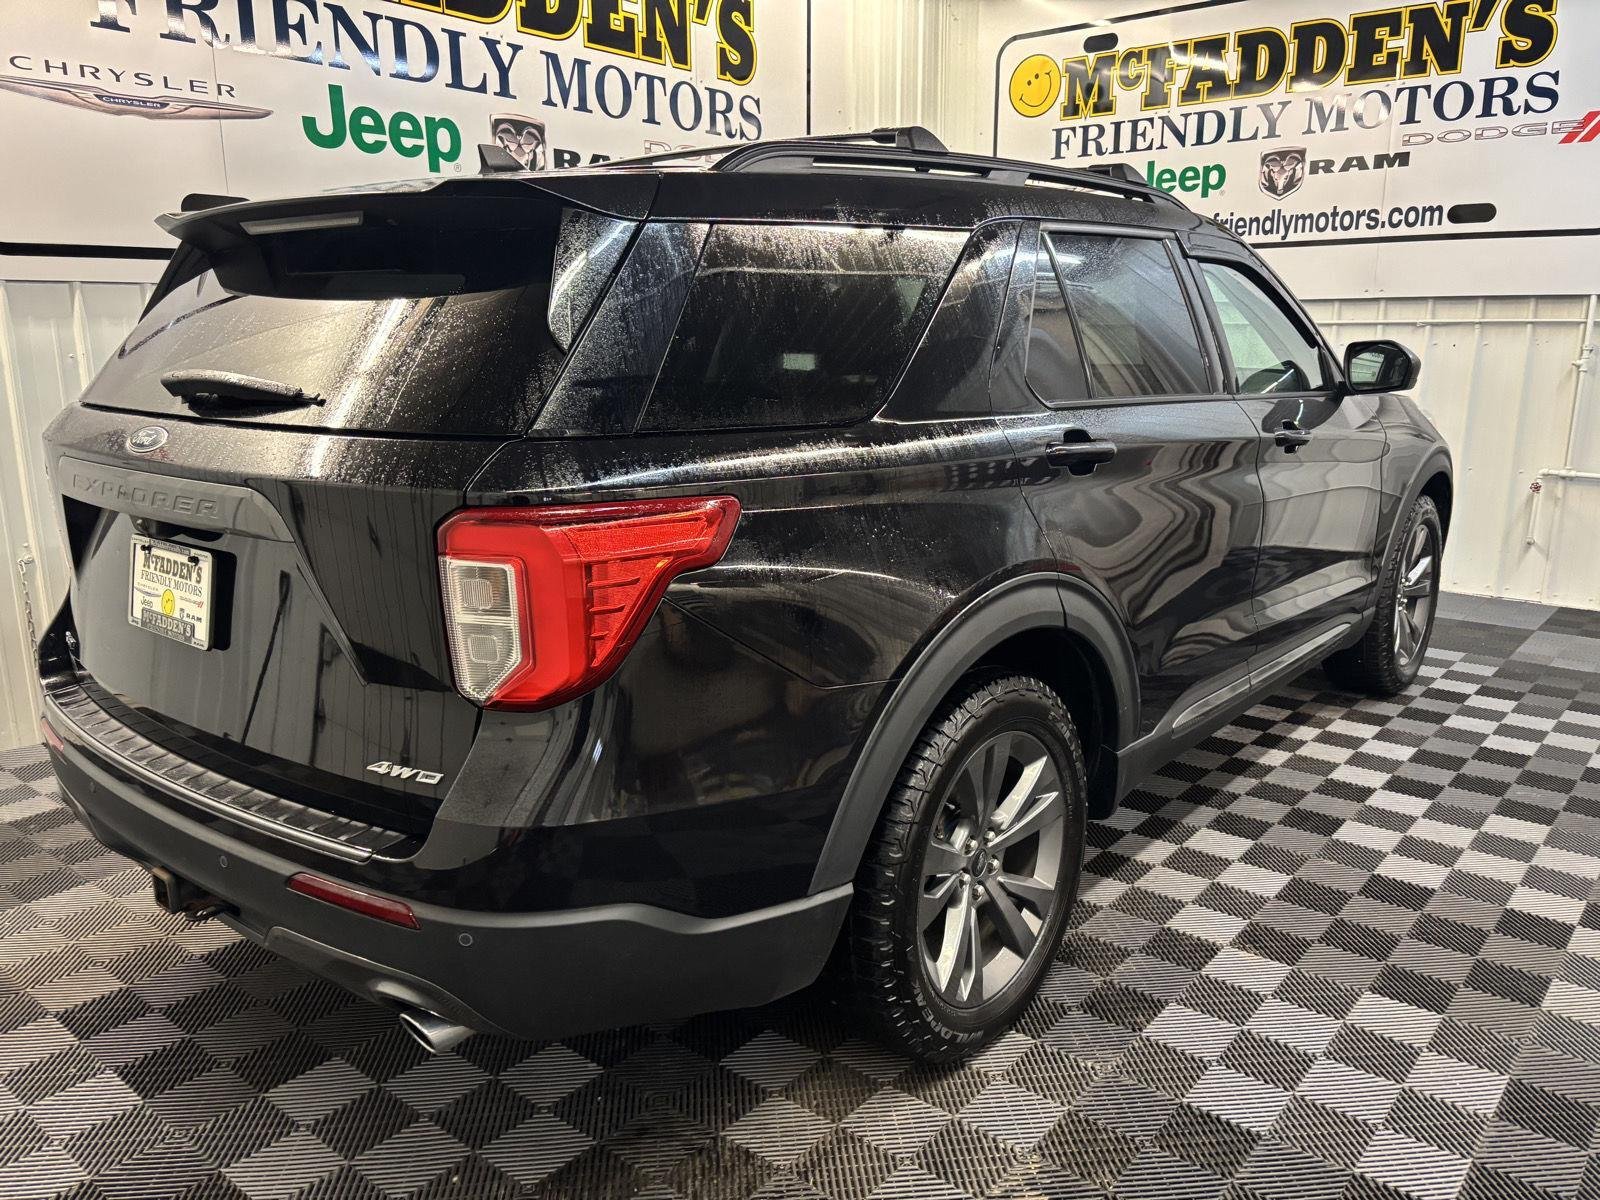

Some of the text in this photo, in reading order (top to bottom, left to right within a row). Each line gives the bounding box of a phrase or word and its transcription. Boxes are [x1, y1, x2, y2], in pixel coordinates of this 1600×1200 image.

[9, 55, 235, 98] CHRYSLER
[102, 96, 161, 108] CHRYSLER
[540, 50, 762, 141] MOTORS
[302, 83, 462, 173] Jeep
[1050, 70, 1560, 160] FRIENDLY MOTORS
[1402, 118, 1586, 146] DODGE
[1308, 151, 1411, 176] RAM
[140, 569, 203, 597] FRIENDLY MOTORS
[366, 761, 444, 785] 4WD
